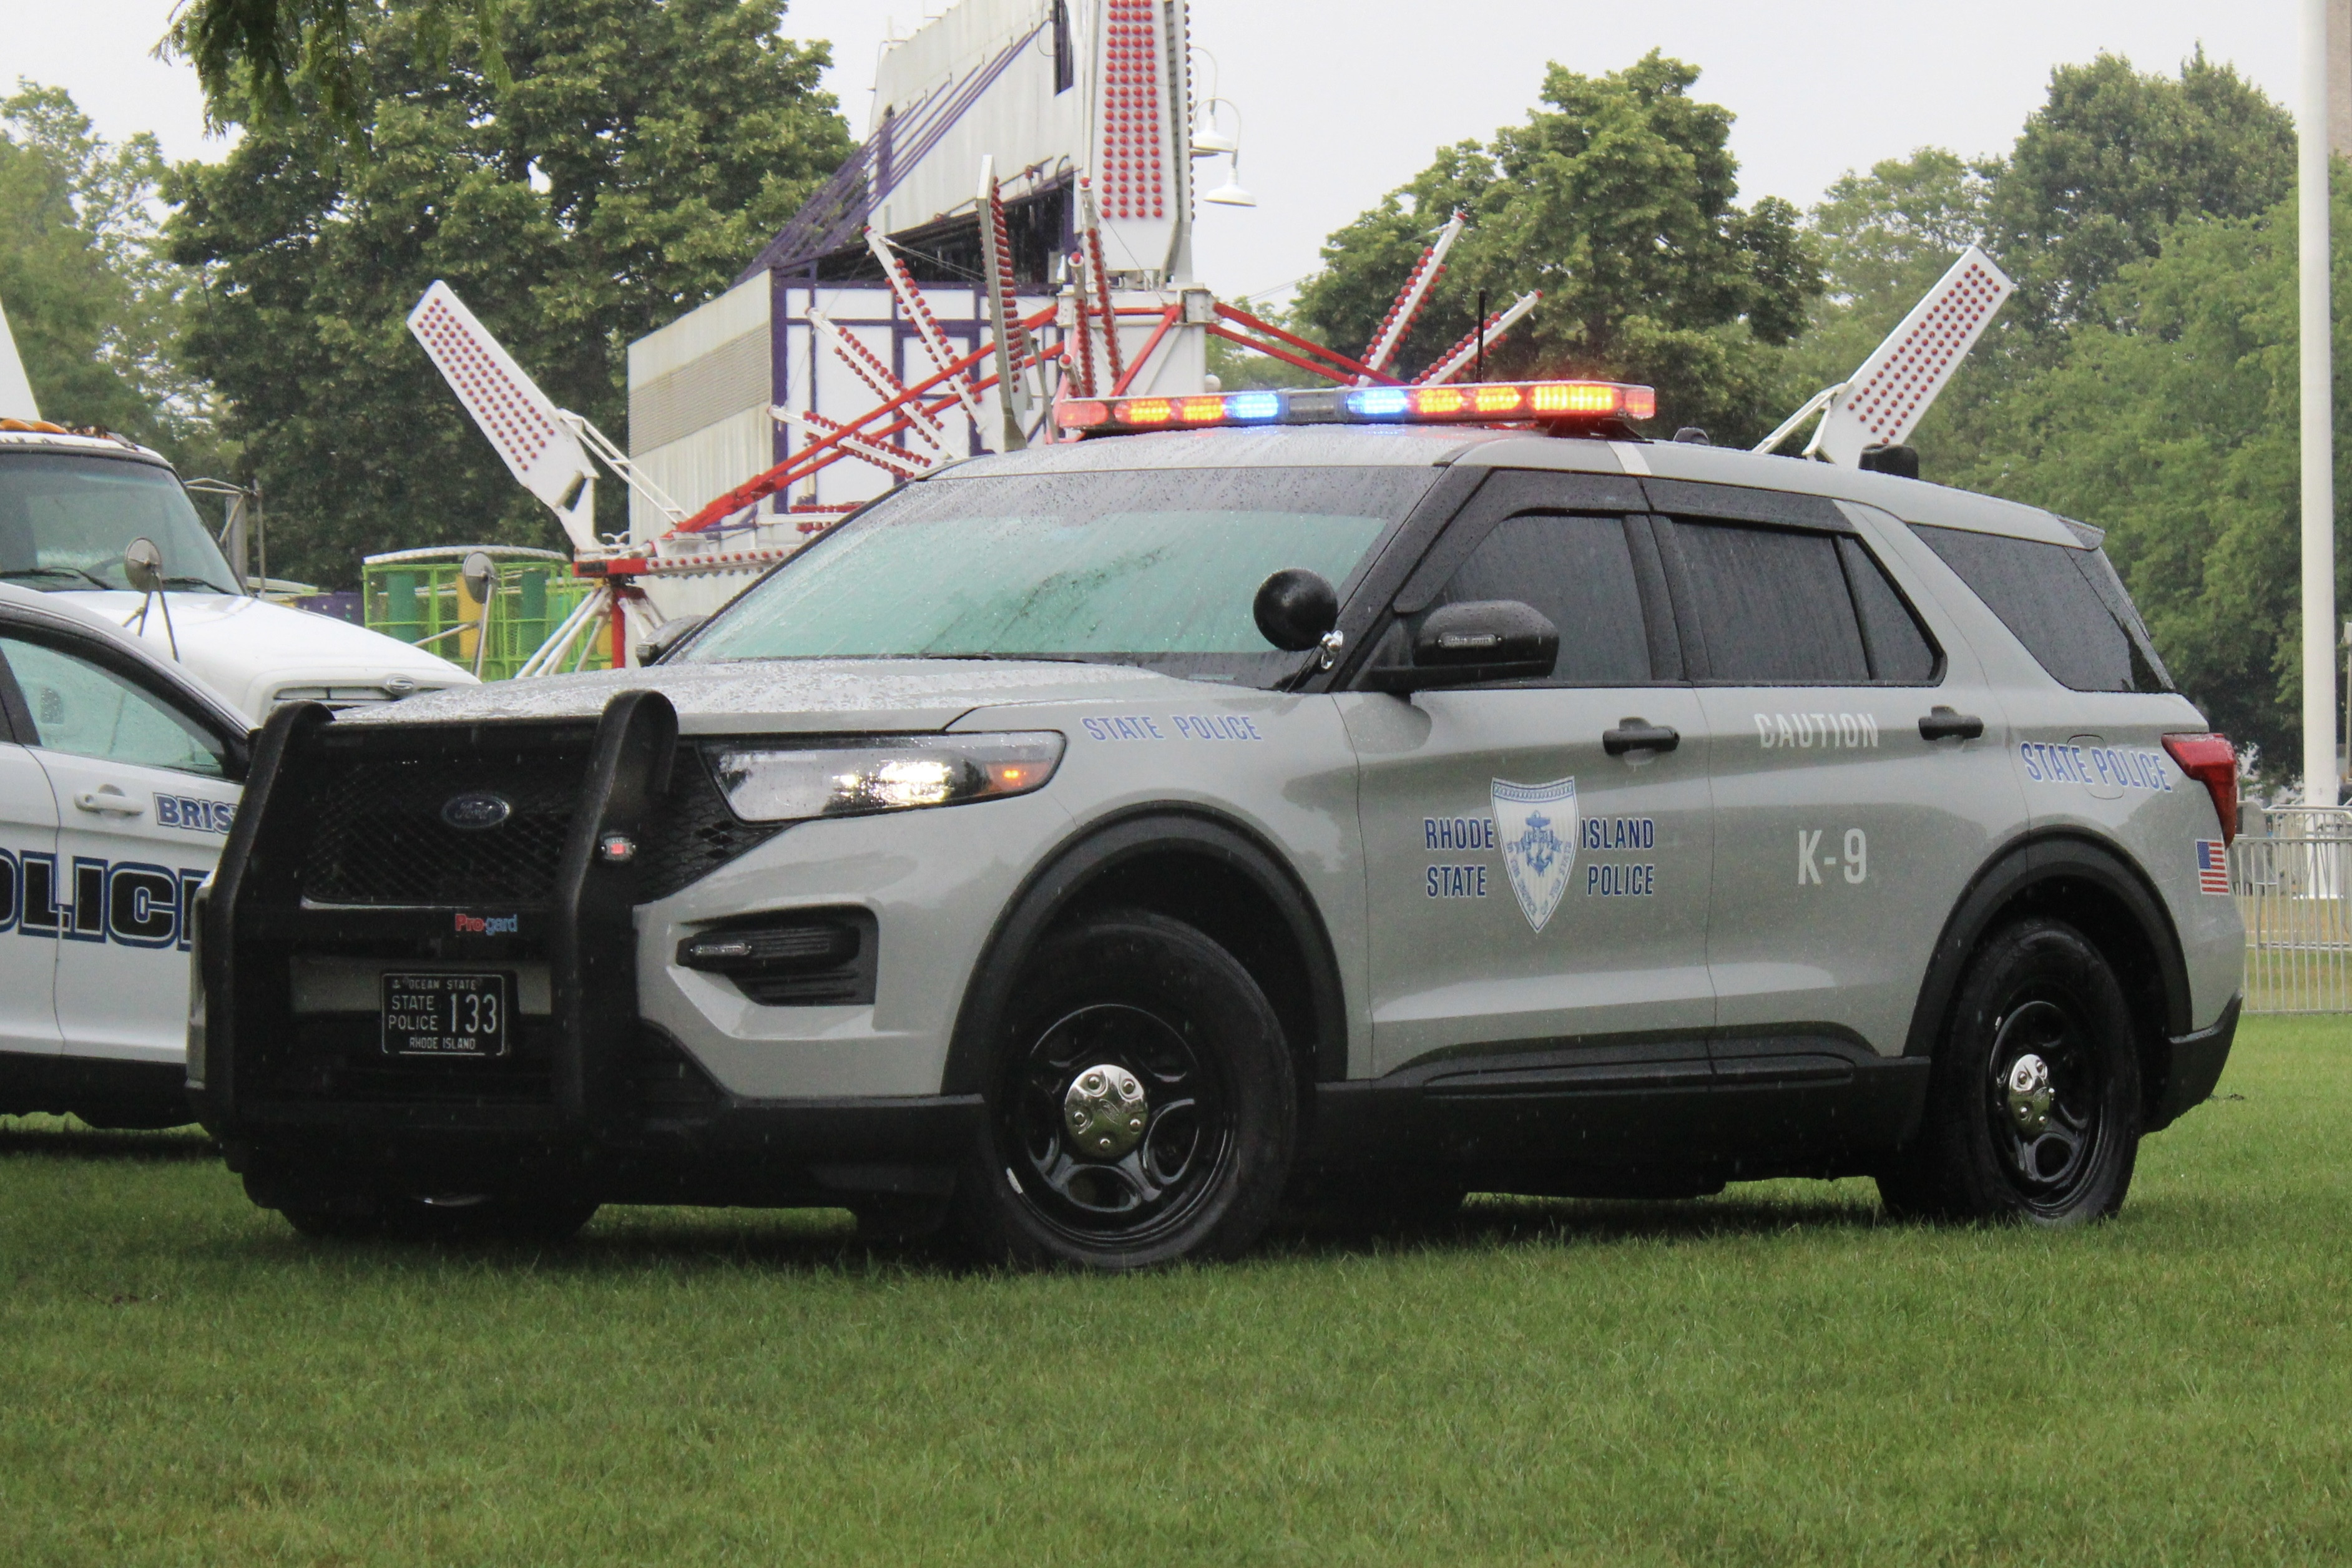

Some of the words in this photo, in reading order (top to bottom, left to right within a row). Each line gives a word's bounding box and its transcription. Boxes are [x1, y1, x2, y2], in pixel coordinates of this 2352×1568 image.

[1080, 715, 1165, 742] STATE
[1170, 715, 1263, 742] POLICE
[1754, 713, 1878, 748] CAUTION
[2020, 742, 2094, 785] STATE
[2089, 747, 2172, 793] POLICE
[153, 793, 238, 835] BRIS
[1423, 817, 1494, 850] RHODE
[1581, 817, 1654, 850] ISLAND
[1797, 828, 1866, 885] K-9
[1426, 865, 1486, 898] STATE
[1587, 864, 1654, 896] POLICE
[409, 979, 439, 989] OCEAN
[447, 979, 476, 990] STATE
[392, 996, 434, 1011] STATE
[450, 993, 497, 1034] 133
[388, 1015, 438, 1030] POLICE
[409, 1037, 438, 1049] RHODE
[443, 1037, 476, 1050] ISLAND
